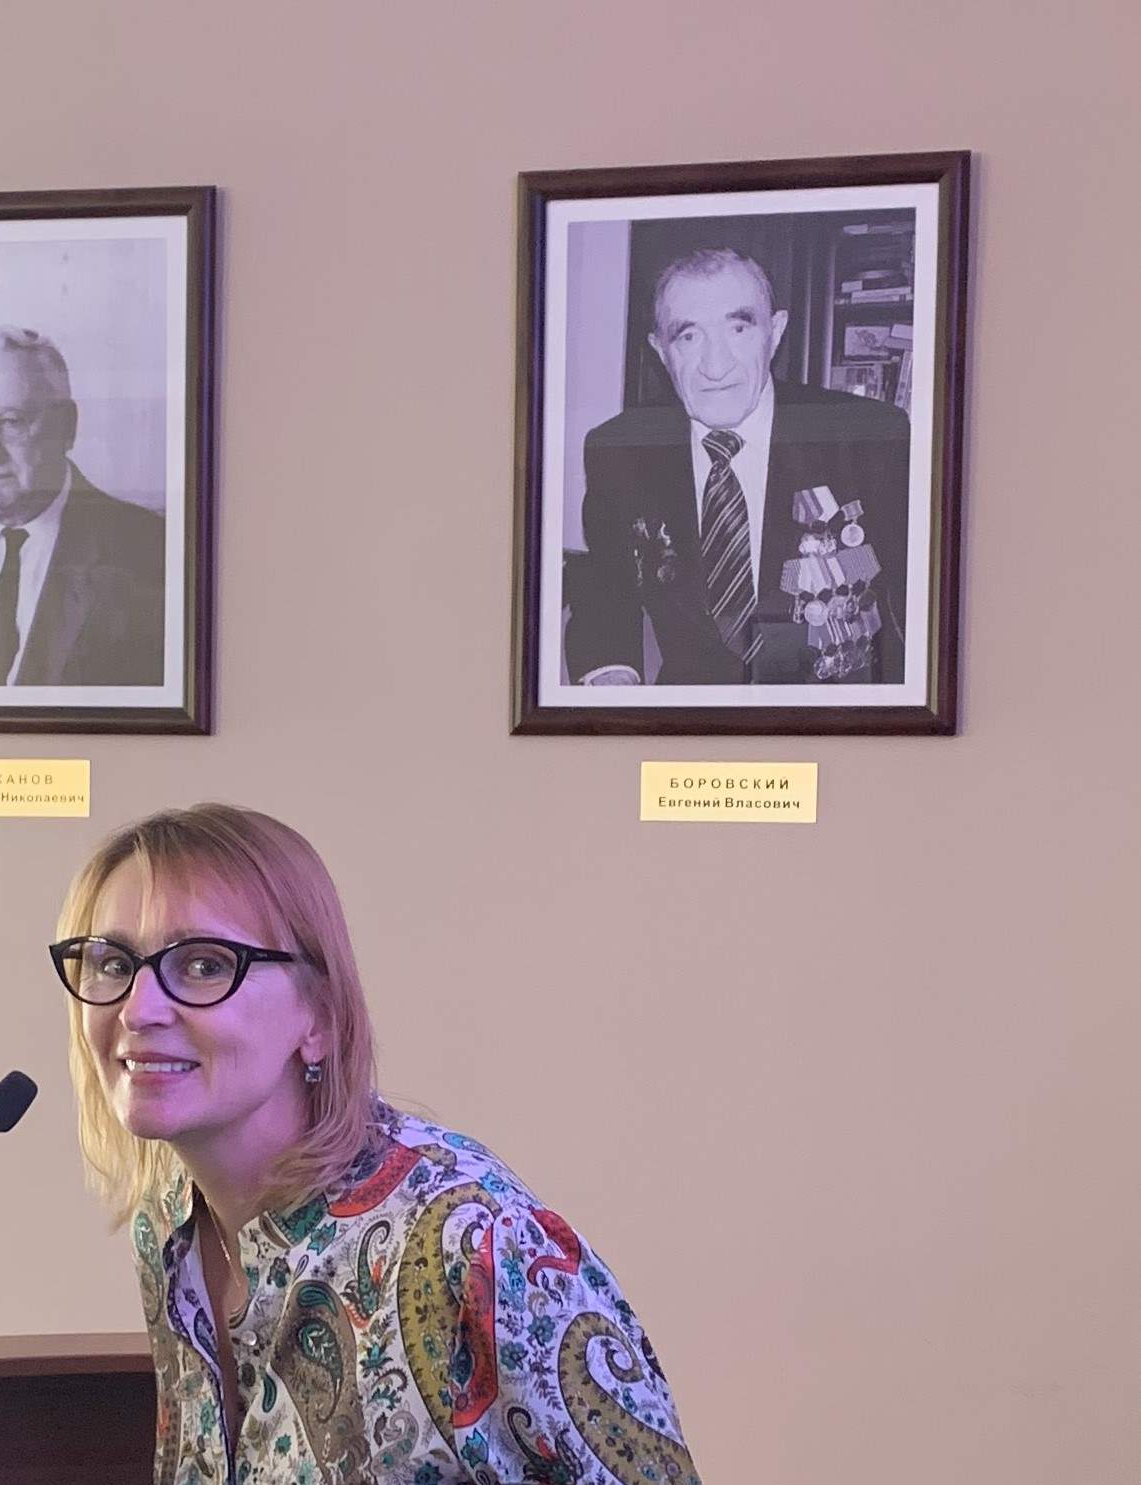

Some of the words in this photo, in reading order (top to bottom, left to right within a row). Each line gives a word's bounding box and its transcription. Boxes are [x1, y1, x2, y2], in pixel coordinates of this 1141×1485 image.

[670, 777, 790, 790] БОРОВСКИЙ
[1, 792, 84, 803] Николаевич
[658, 796, 720, 808] Евгений
[725, 797, 800, 809] Власович
